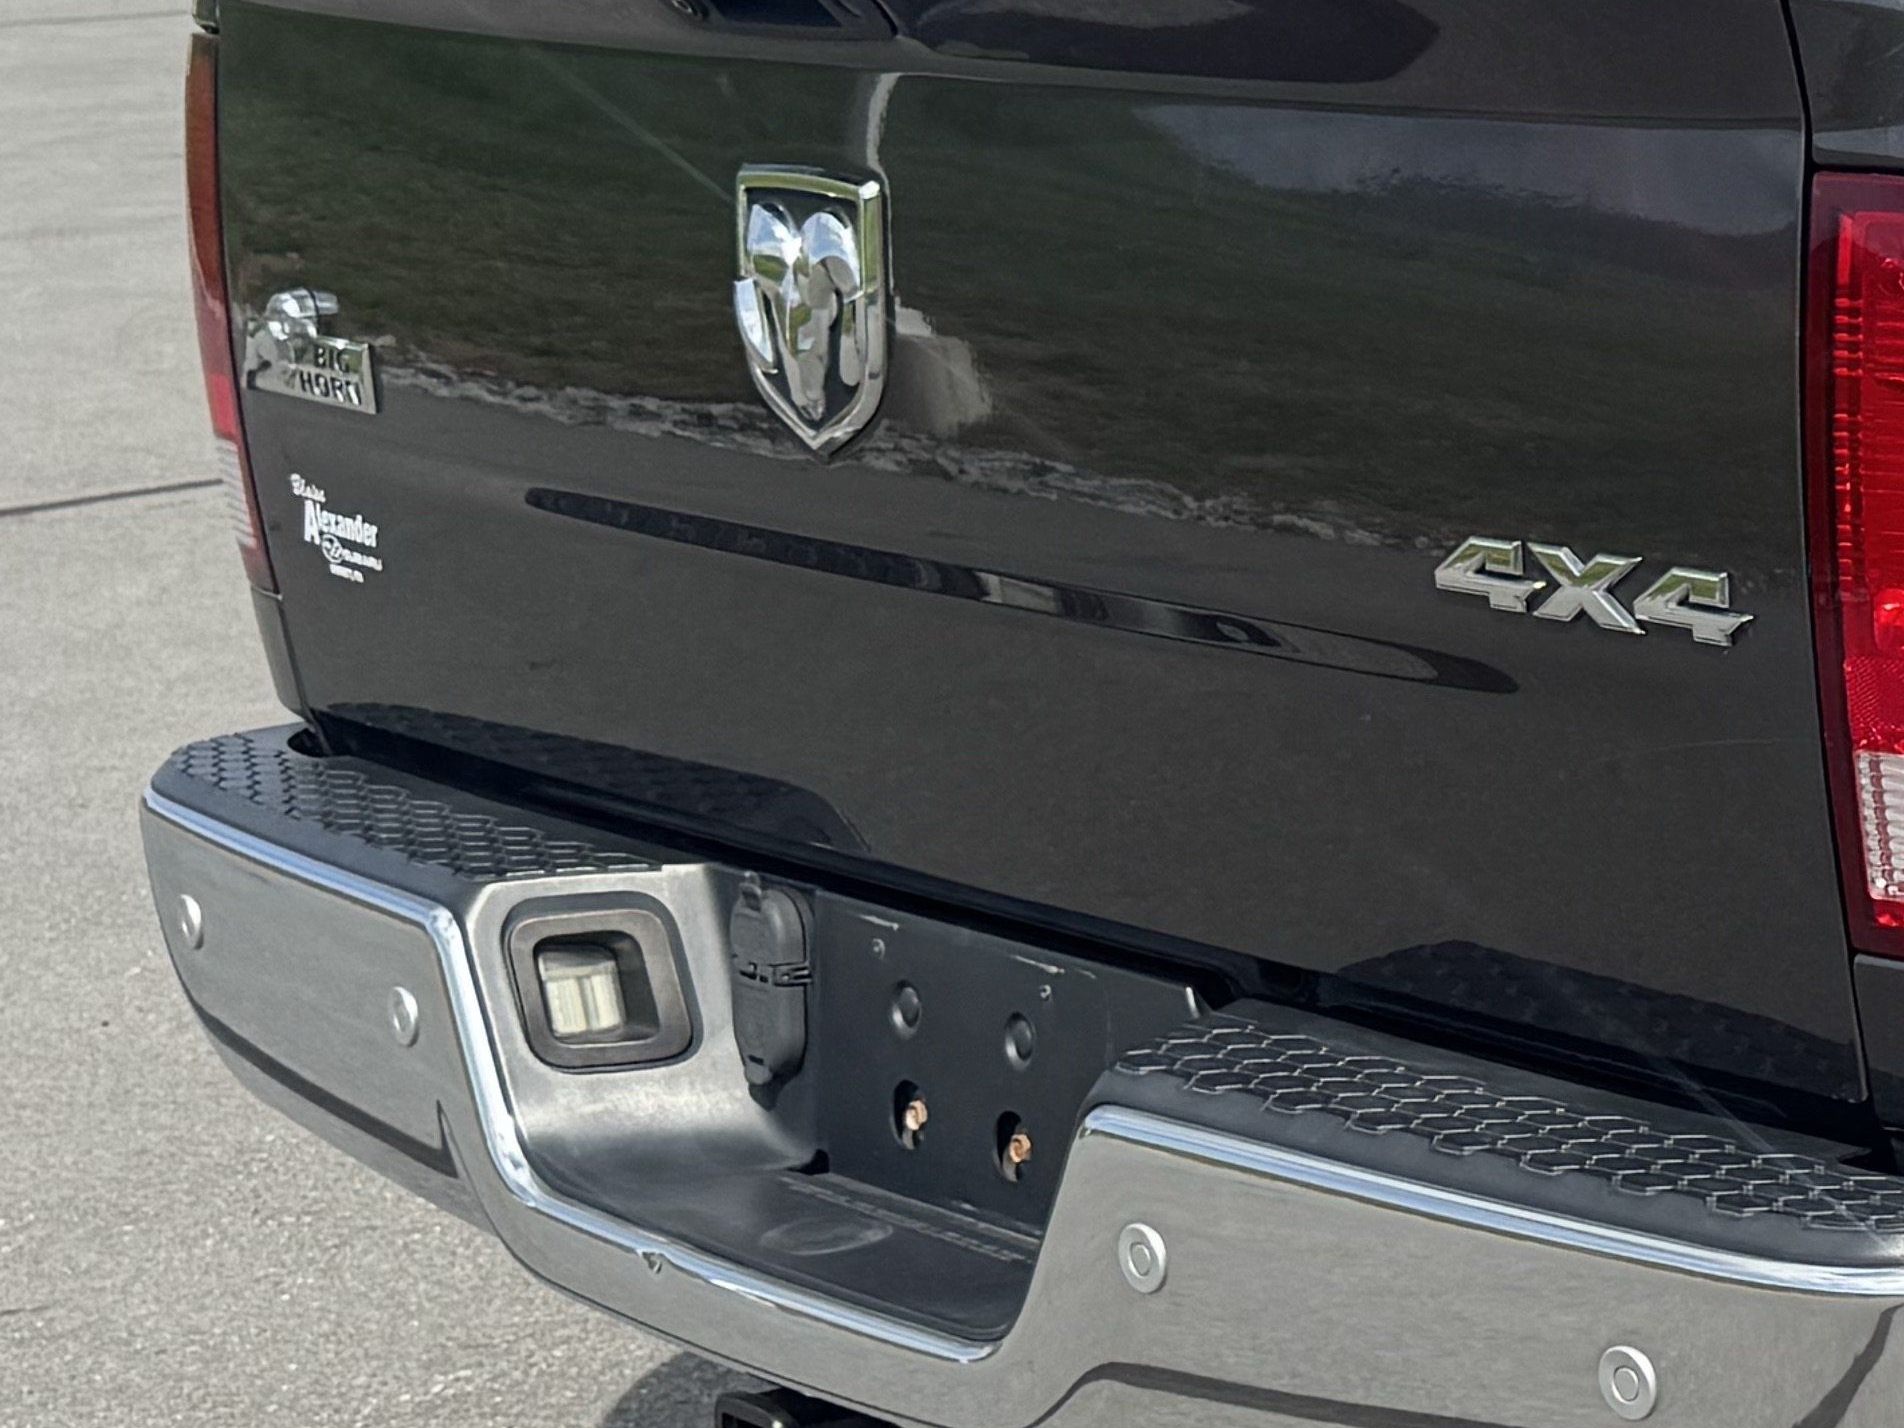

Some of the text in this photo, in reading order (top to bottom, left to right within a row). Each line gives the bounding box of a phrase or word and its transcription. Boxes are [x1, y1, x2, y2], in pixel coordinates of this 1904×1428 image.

[314, 345, 351, 373] BIG
[300, 370, 362, 406] HORN
[304, 499, 378, 548] Alexander
